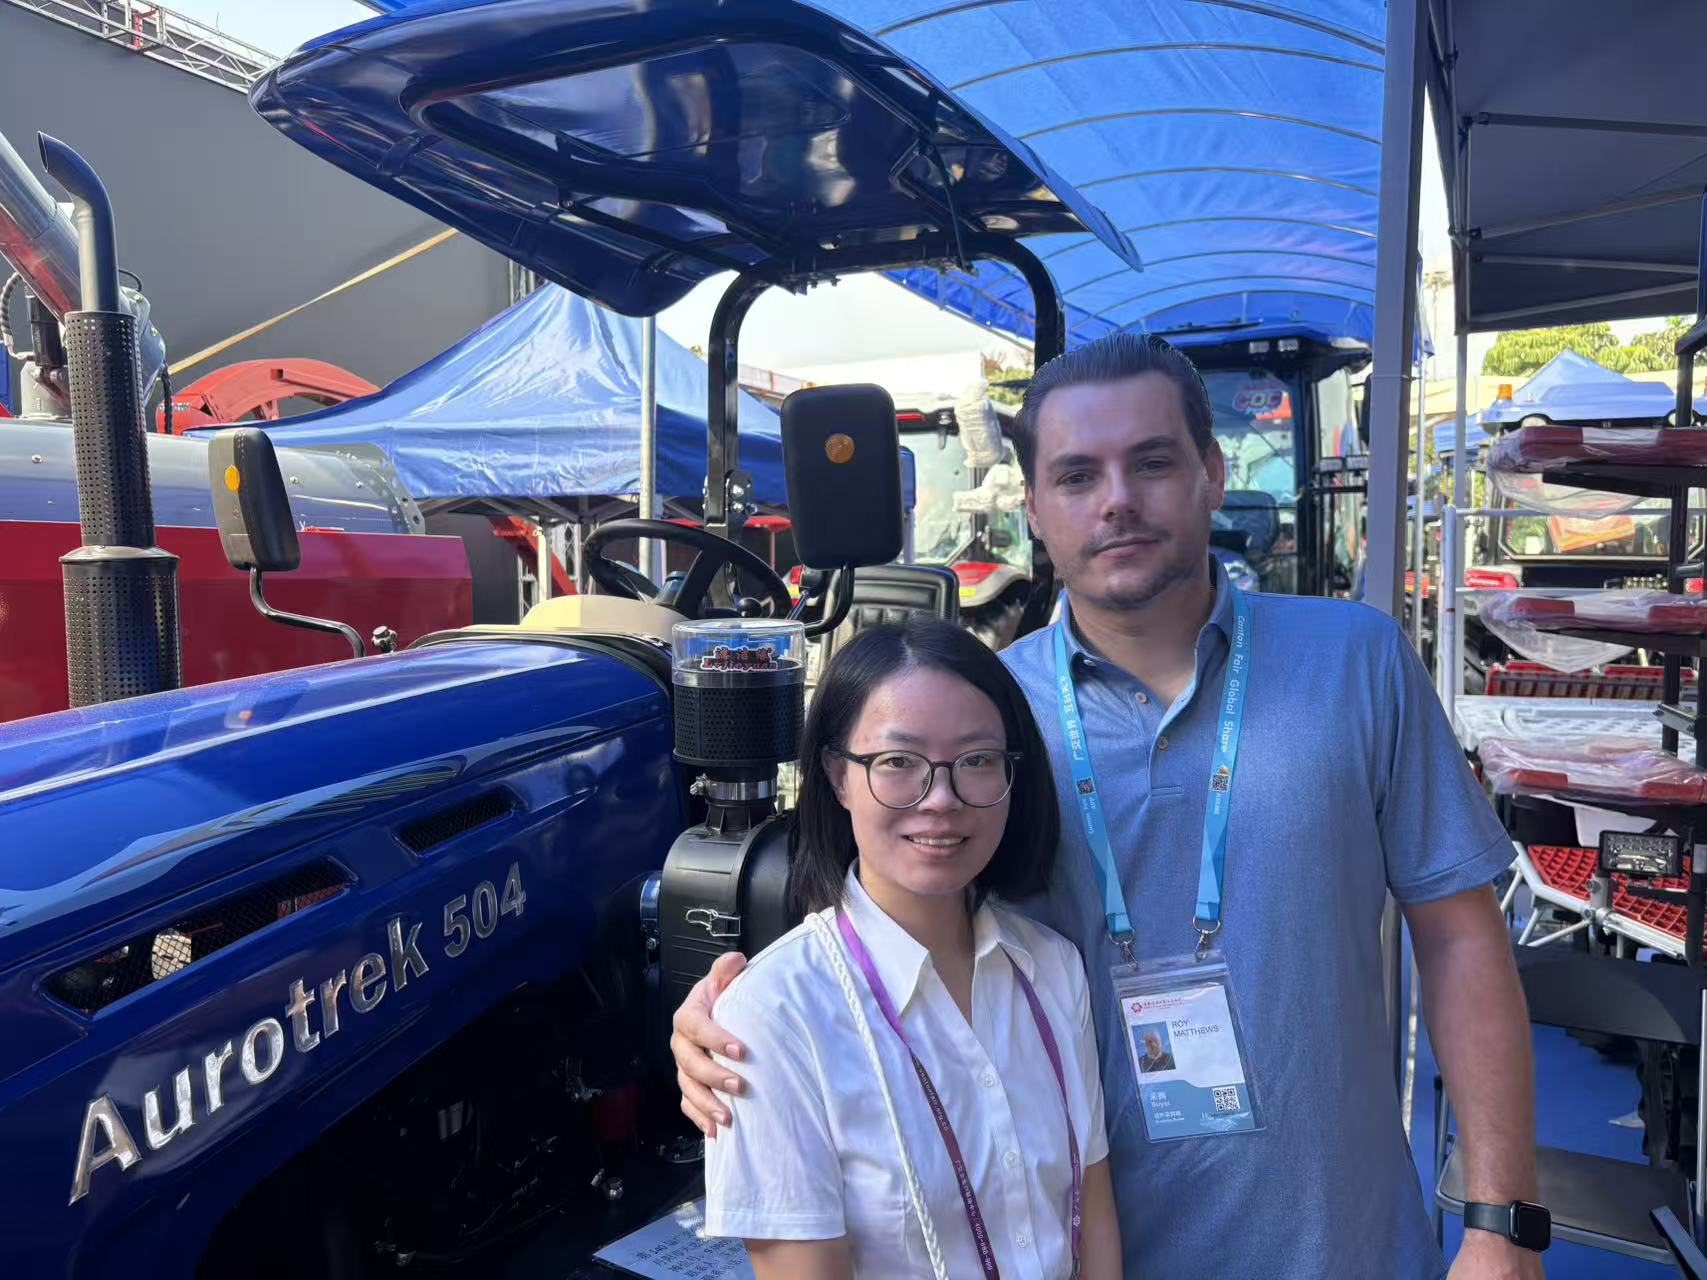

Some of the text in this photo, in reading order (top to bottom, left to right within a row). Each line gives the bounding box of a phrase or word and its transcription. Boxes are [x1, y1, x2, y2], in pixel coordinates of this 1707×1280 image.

[1220, 615, 1246, 753] Canton Fair Global Share
[68, 861, 527, 1206] Aurotrek 504
[1171, 1019, 1190, 1029] ROY
[1173, 1024, 1220, 1037] MATTHEWS
